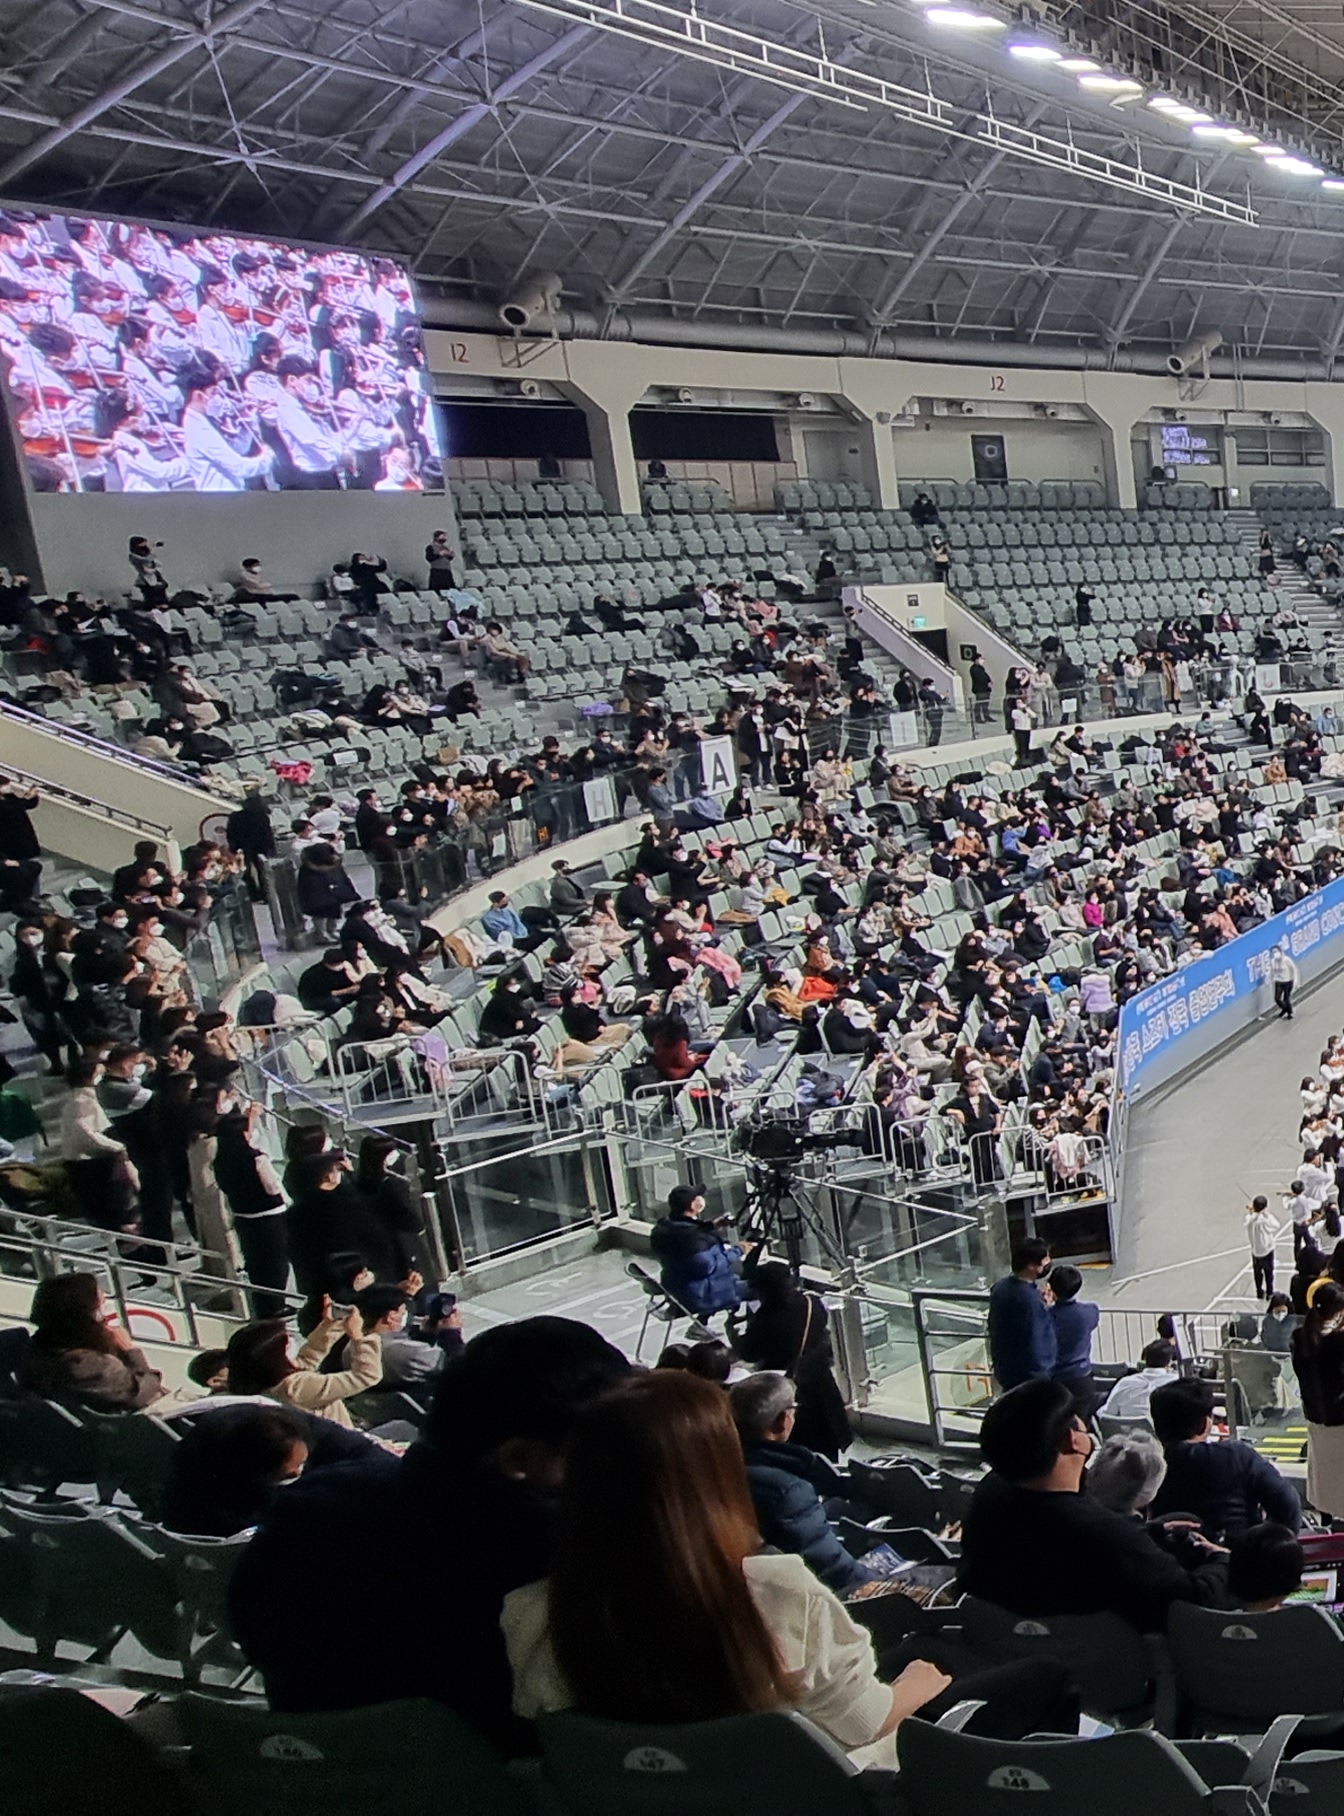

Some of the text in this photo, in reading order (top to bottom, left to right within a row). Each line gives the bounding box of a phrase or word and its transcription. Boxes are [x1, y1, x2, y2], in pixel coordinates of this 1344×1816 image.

[451, 344, 469, 364] I2
[991, 376, 1005, 392] J2
[710, 751, 731, 790] A
